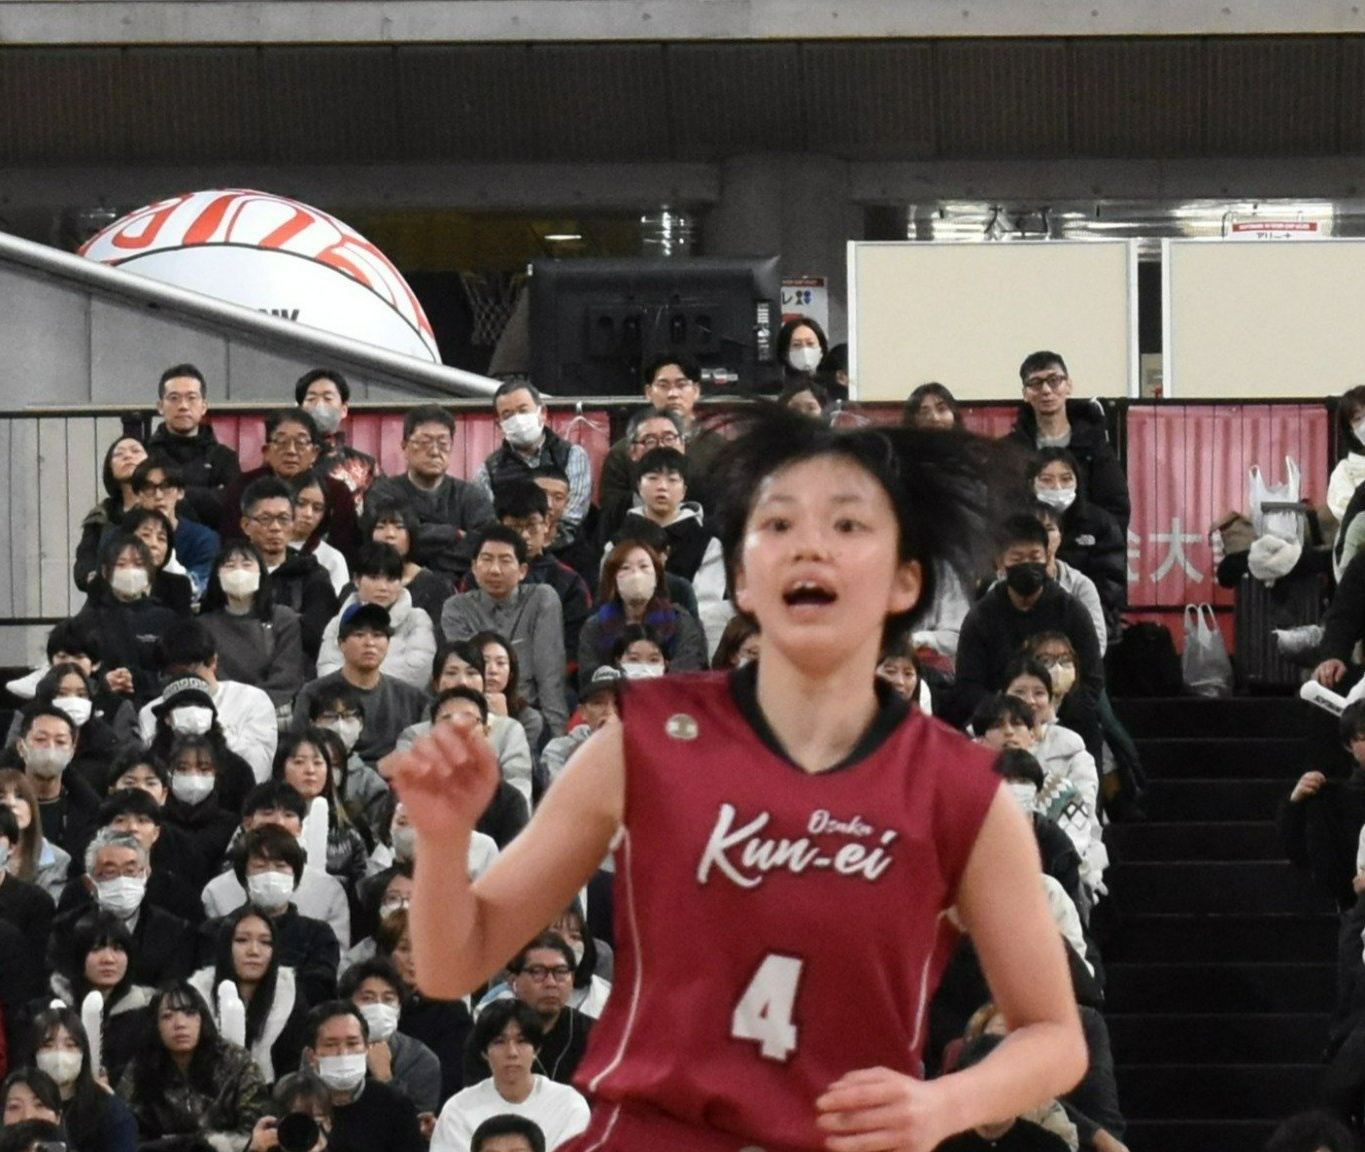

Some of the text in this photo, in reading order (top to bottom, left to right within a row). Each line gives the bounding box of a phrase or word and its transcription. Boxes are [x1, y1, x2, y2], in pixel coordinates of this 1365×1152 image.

[696, 803, 897, 887] Kun-ei
[808, 810, 873, 837] Osaka
[731, 953, 803, 1063] 4
